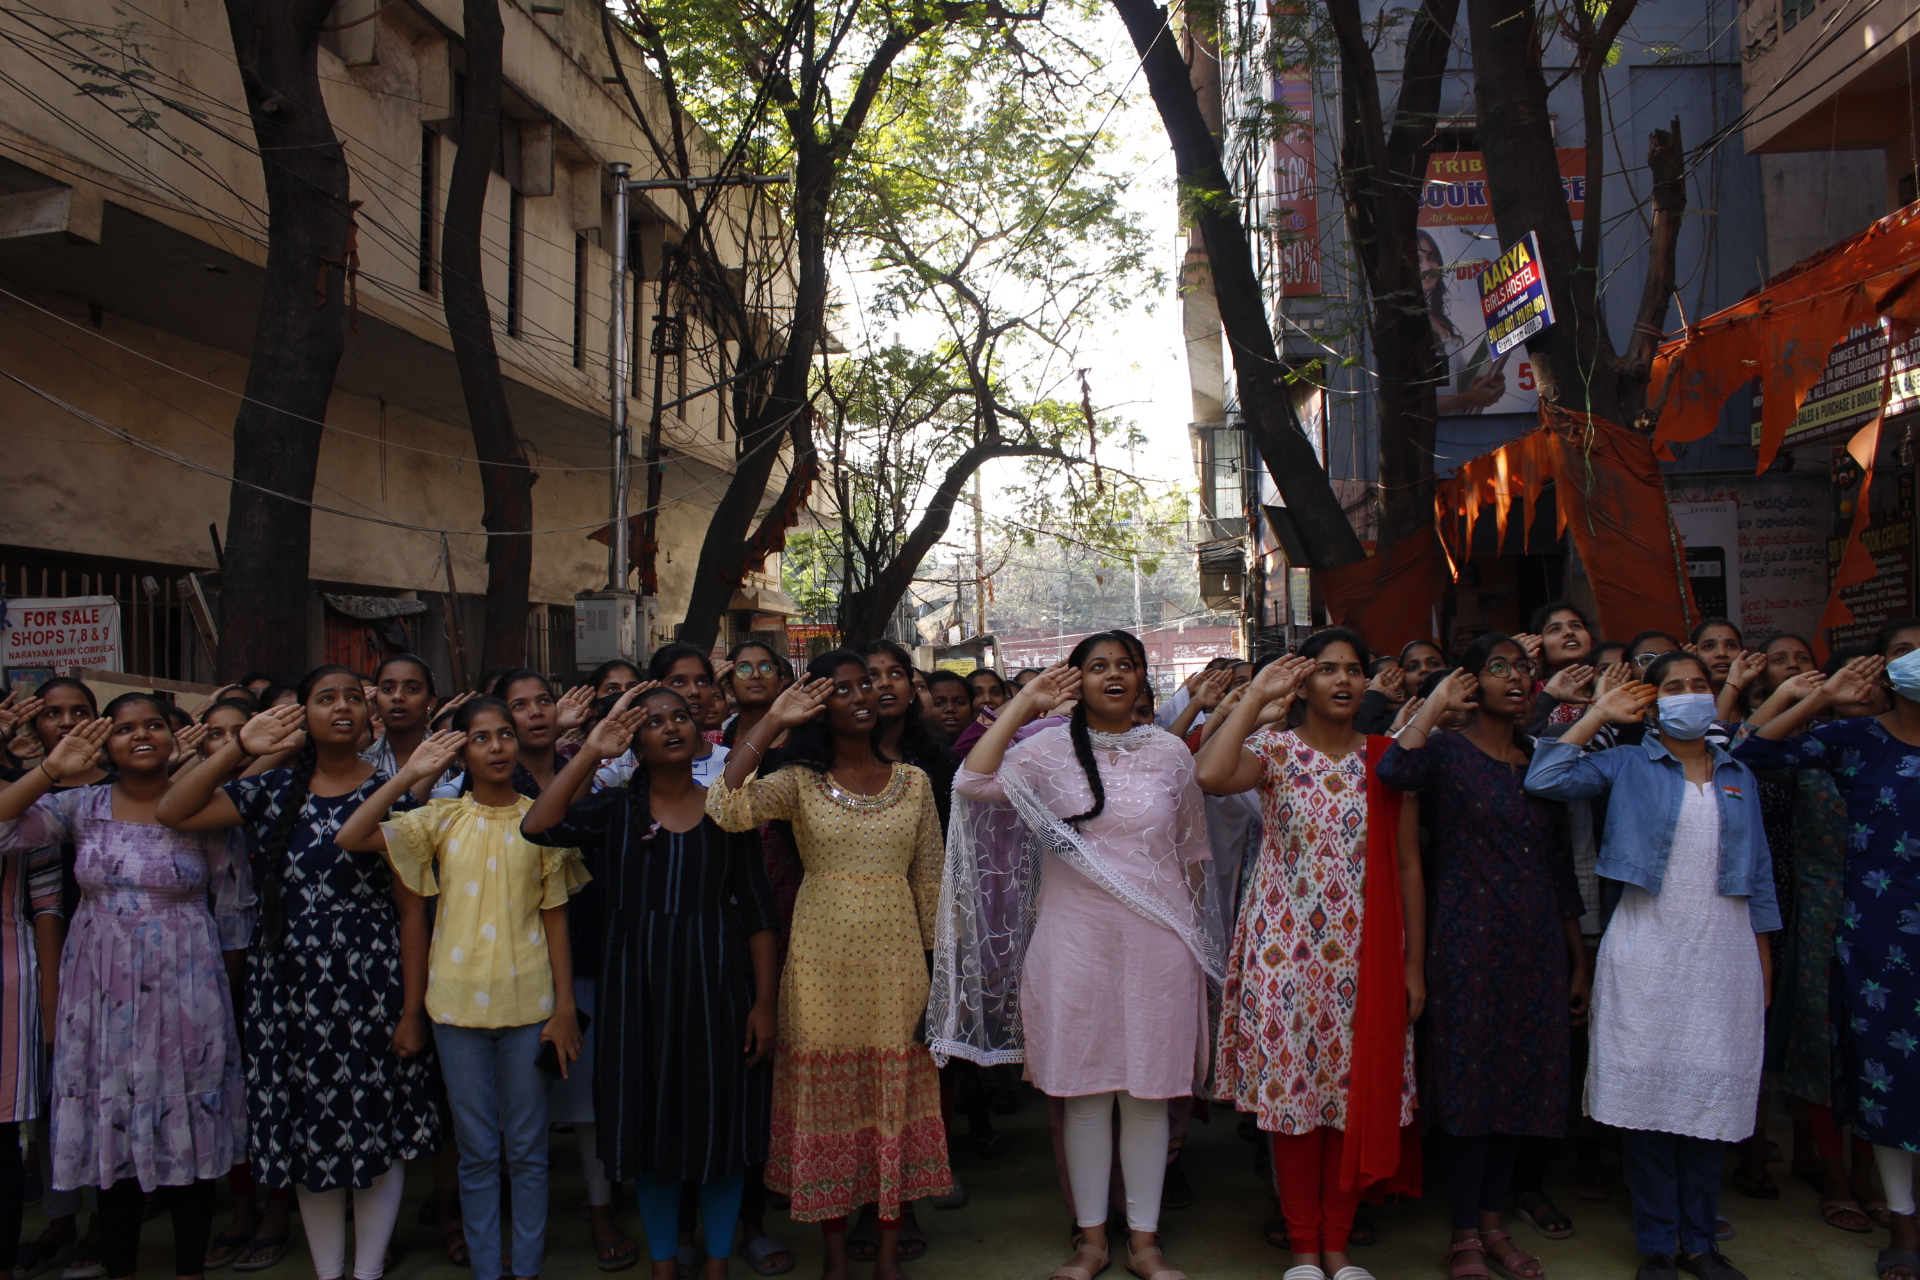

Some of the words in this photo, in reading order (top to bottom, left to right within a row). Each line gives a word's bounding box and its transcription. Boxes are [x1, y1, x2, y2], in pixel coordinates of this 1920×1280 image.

[1432, 158, 1483, 174] TRIB
[1279, 156, 1314, 201] 10%
[1292, 213, 1306, 229] to
[1282, 239, 1318, 284] 50%
[1456, 260, 1493, 280] DISC
[1483, 241, 1531, 295] AARYA
[1484, 287, 1507, 313] GIRLS
[1506, 266, 1536, 299] HOSTEL
[1517, 362, 1537, 391] 5
[1827, 369, 1833, 381] IN
[1834, 366, 1847, 379] ONE
[1849, 354, 1879, 375] QUESTION
[1814, 387, 1826, 400] ALL
[1826, 371, 1867, 397] COMPETITIVE
[1867, 363, 1886, 381] BOOK
[1798, 407, 1815, 425] SALES
[1821, 397, 1849, 420] PURCHASE
[1857, 388, 1877, 408] BOOKS
[1882, 521, 1910, 550] CENTRE
[1863, 579, 1883, 590] School
[1884, 576, 1903, 586] Books
[1887, 587, 1907, 597] Books
[24, 611, 56, 627] FOR
[62, 609, 99, 625] SALE
[1869, 613, 1888, 622] Books
[11, 630, 65, 646] SHOPS
[69, 629, 87, 644] 7,8
[91, 627, 100, 642] &
[102, 627, 109, 640] 9
[8, 649, 55, 660] NARAYANA
[56, 647, 76, 657] NAIK
[78, 644, 115, 655] COMPLEX
[47, 658, 80, 668] SULTAN
[82, 655, 107, 666] BAZAR
